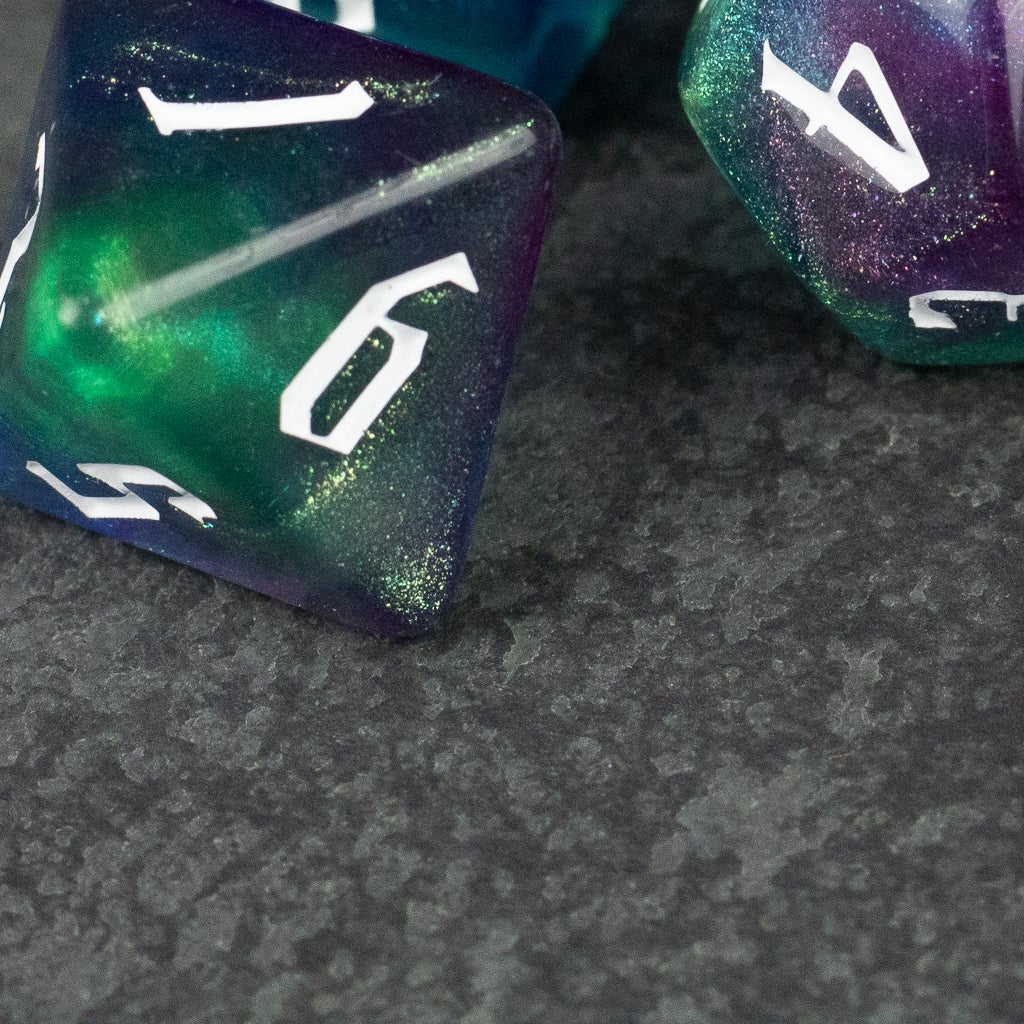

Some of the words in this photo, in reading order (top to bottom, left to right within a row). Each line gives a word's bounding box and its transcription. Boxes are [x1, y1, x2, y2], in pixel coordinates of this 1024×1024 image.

[137, 80, 376, 137] 1
[760, 36, 931, 195] 4
[279, 251, 480, 456] 6
[26, 460, 218, 528] 5
